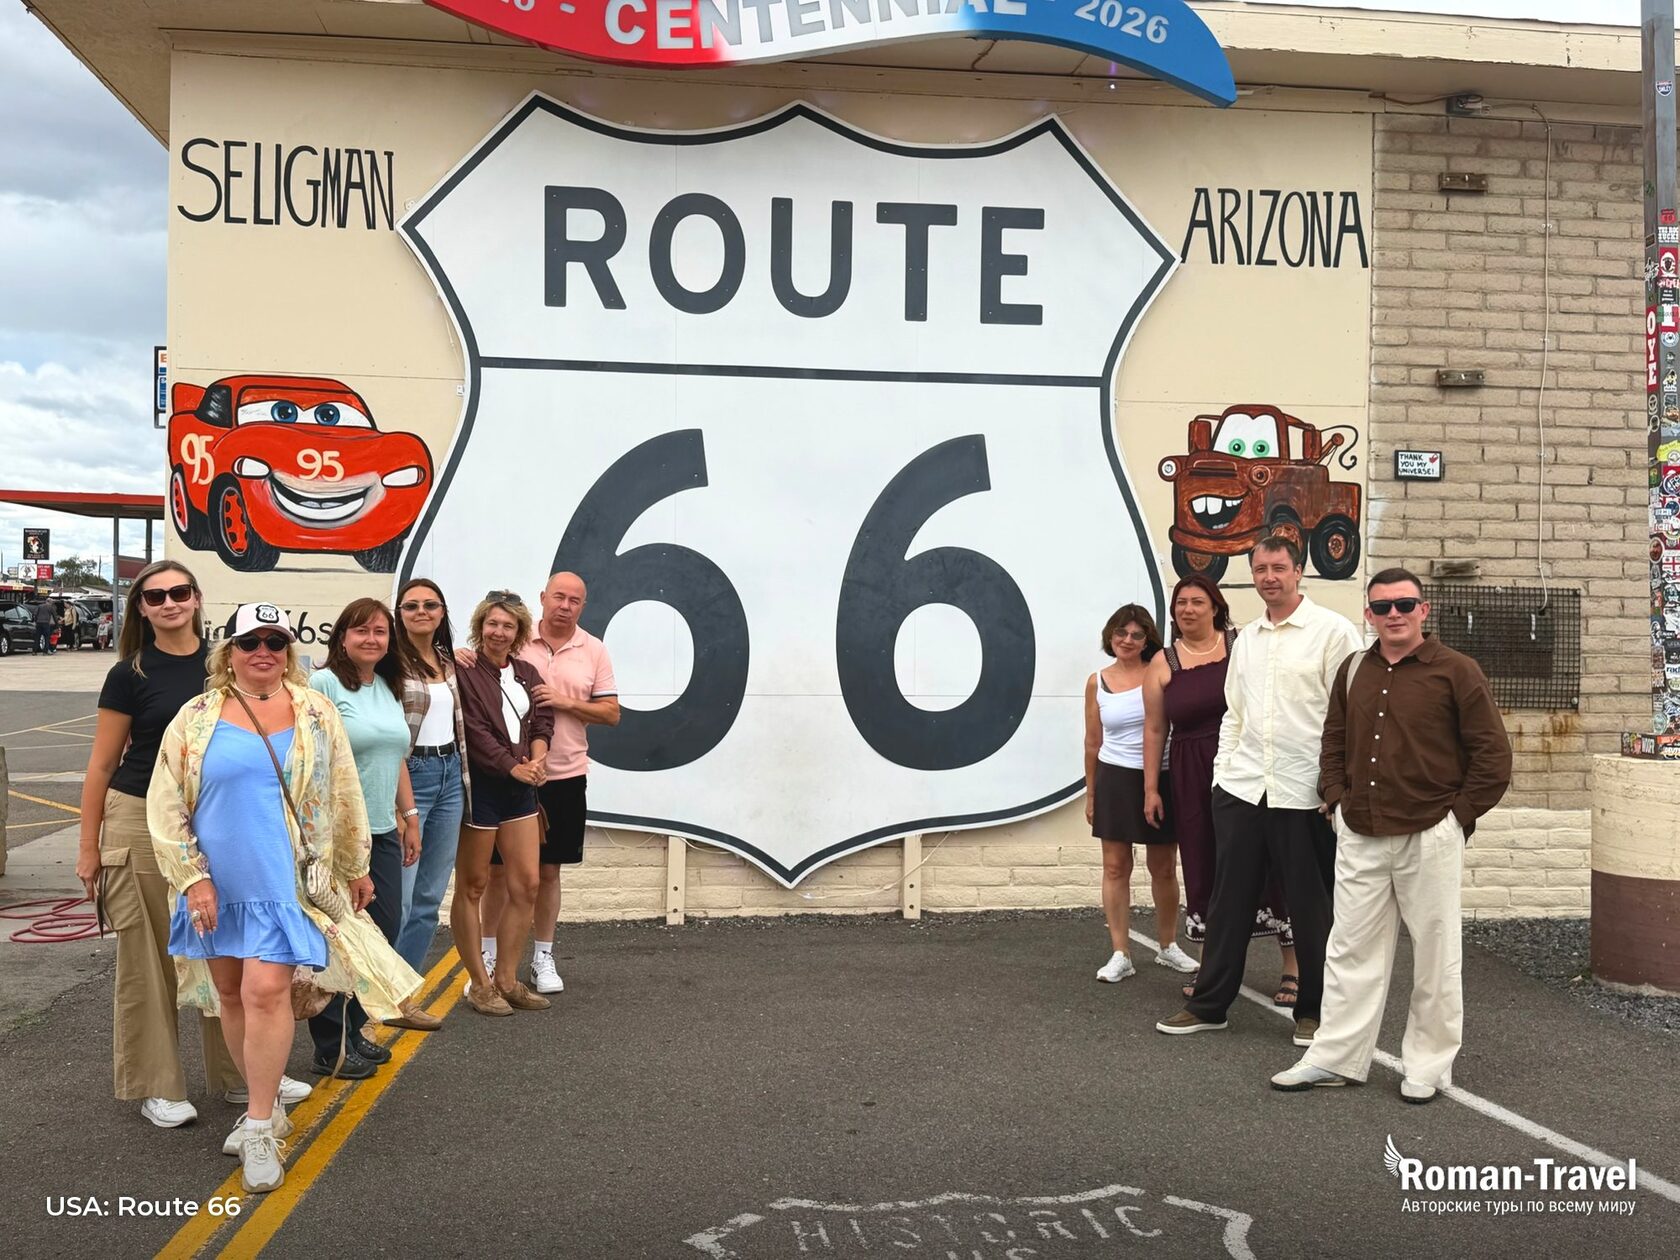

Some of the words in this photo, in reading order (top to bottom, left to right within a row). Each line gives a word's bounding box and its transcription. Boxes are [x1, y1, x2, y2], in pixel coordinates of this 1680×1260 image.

[604, 0, 1027, 49] CENTEN
[1074, 0, 1169, 44] 2026
[177, 137, 395, 231] SELIGMAN
[544, 185, 1045, 325] ROUTE
[1180, 187, 1369, 269] ARIZONA
[1647, 311, 1657, 385] OYE
[181, 433, 215, 485] 95
[296, 448, 345, 482] 95
[548, 428, 1036, 772] 66
